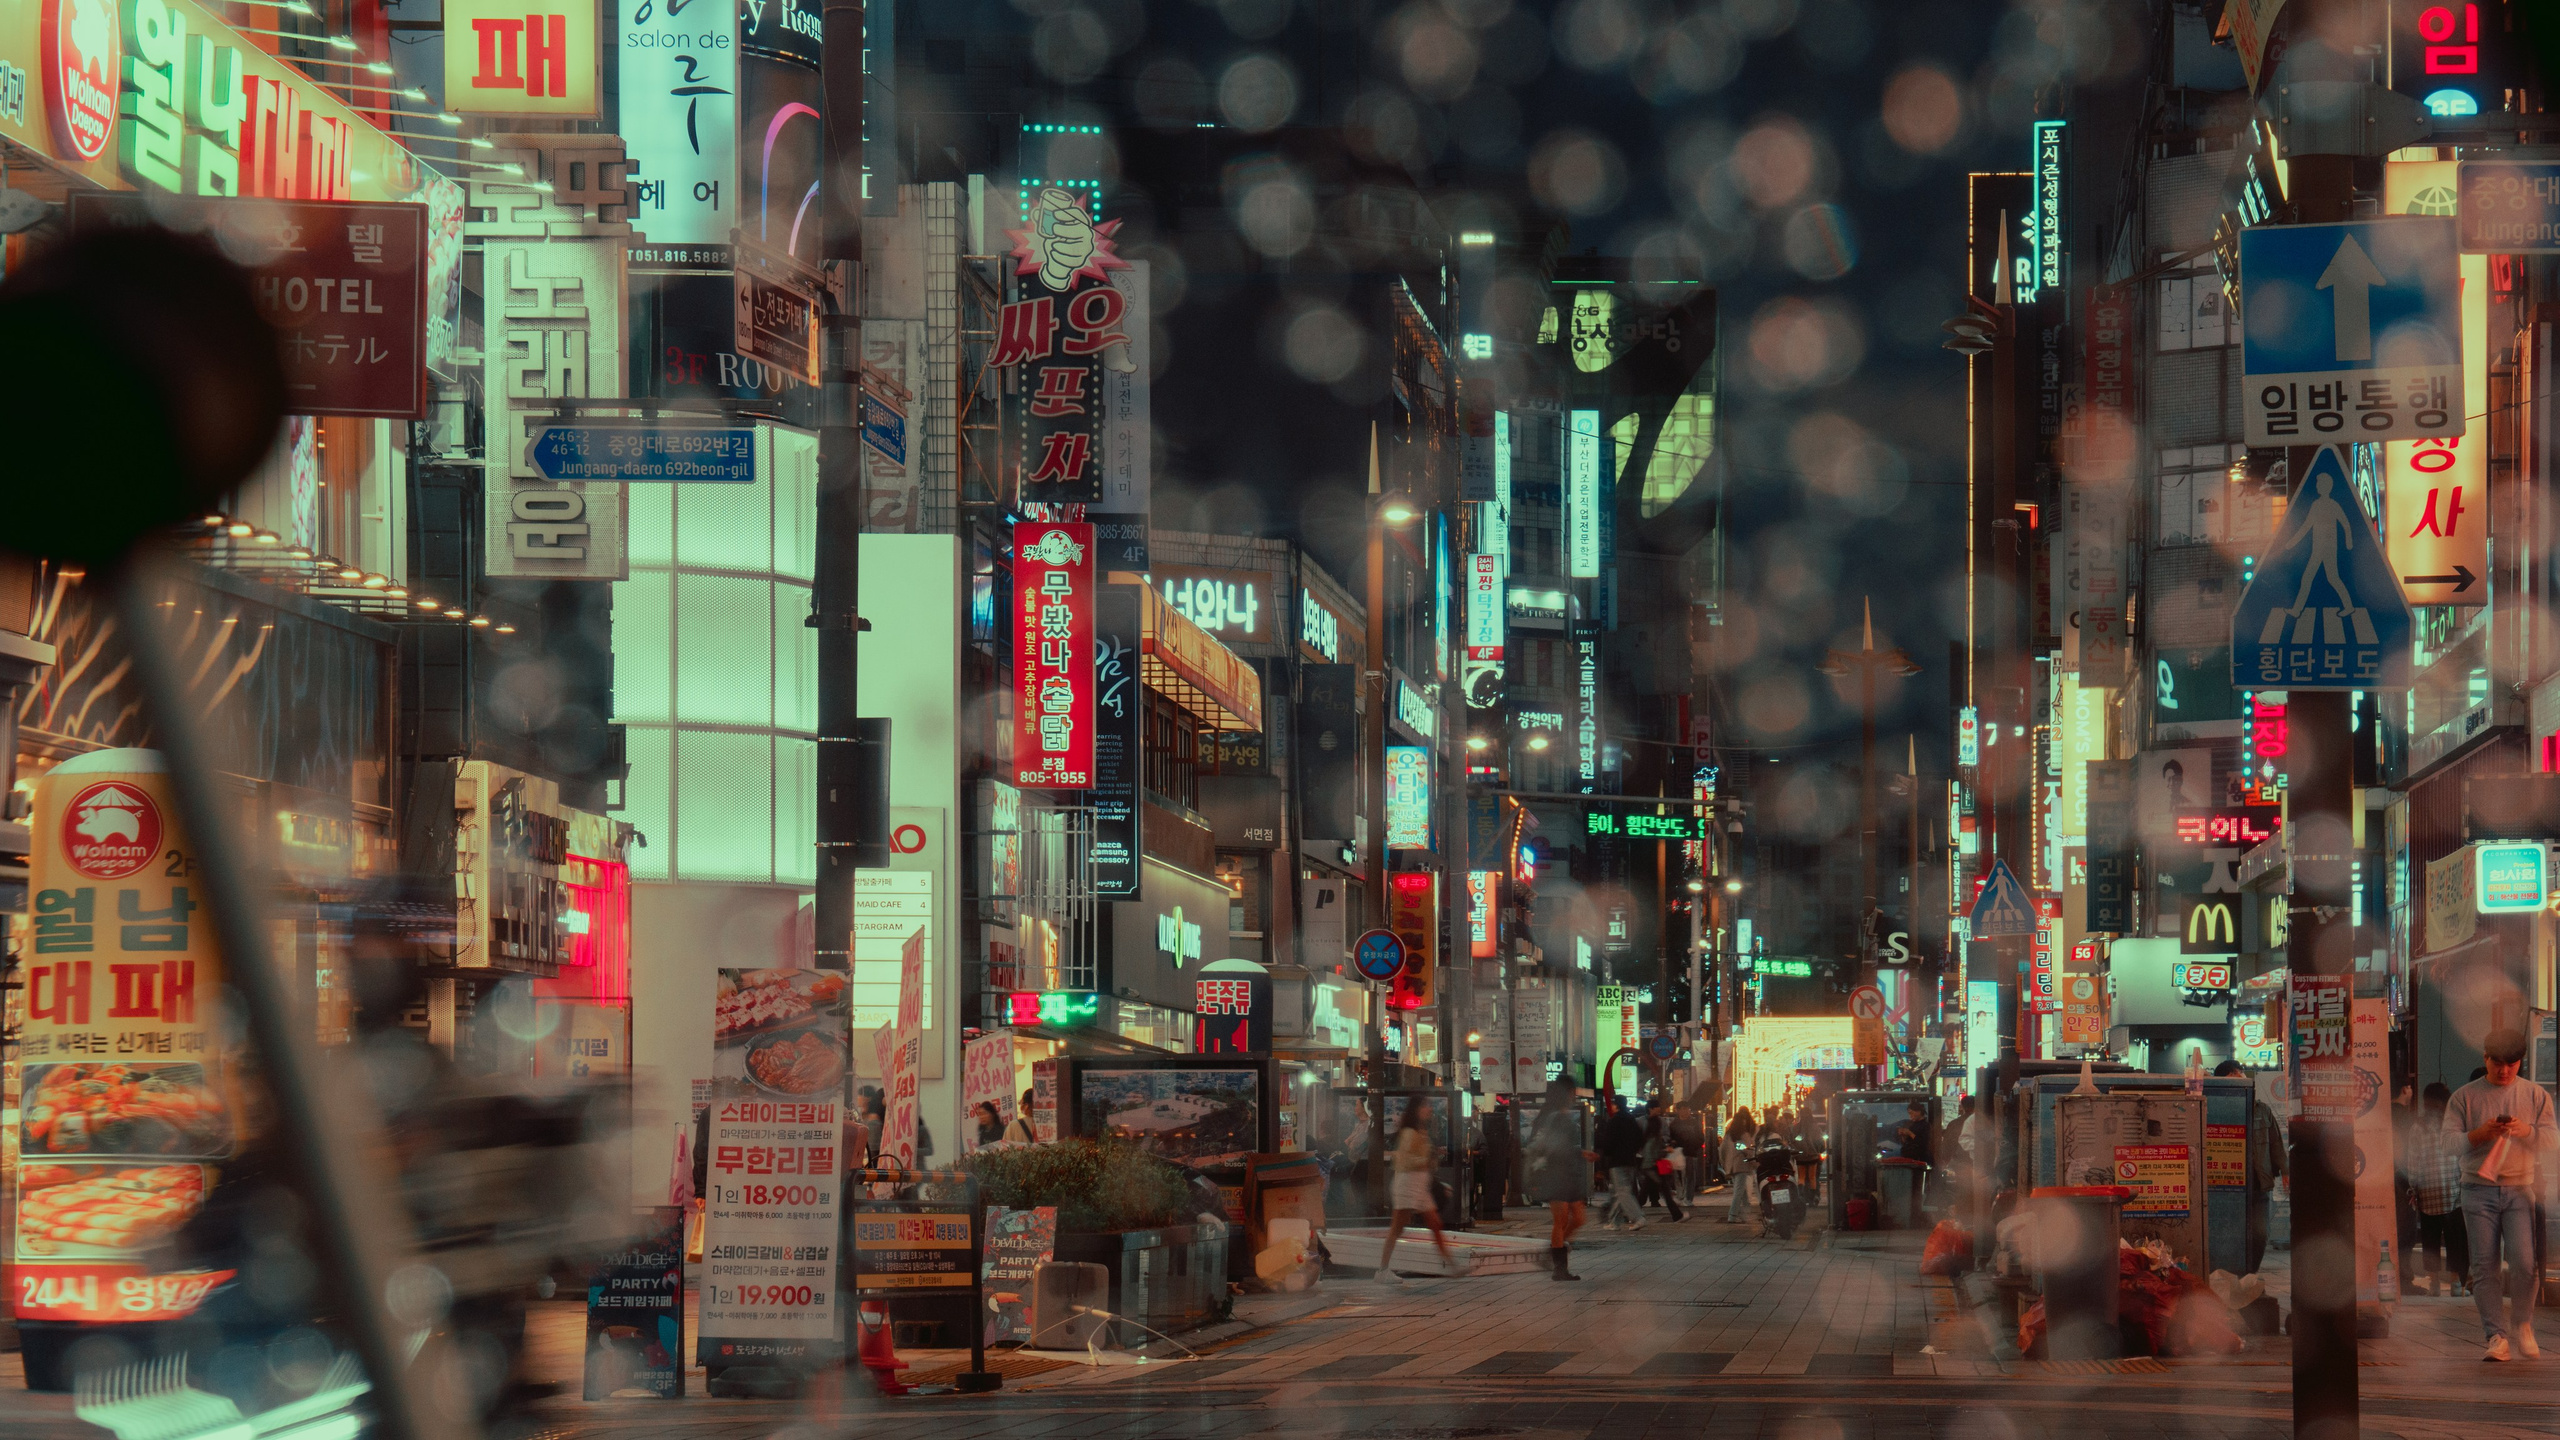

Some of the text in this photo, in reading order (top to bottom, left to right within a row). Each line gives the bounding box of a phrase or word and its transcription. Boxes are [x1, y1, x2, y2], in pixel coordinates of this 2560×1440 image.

[627, 29, 730, 50] salon de
[2419, 4, 2479, 75] 임
[472, 14, 566, 97] 패
[67, 66, 111, 118] Wolnam
[71, 105, 104, 140] Daepae
[258, 277, 384, 315] HOTEL
[2261, 376, 2449, 436] 일방통행
[555, 431, 590, 443] 46-2
[551, 443, 590, 455] 46-12
[607, 435, 749, 459] 중앙대로692번길
[558, 459, 749, 478] Jungang-daero 692beon-gil
[1122, 546, 1145, 562] 4F
[1024, 615, 1036, 629] 맛
[1024, 631, 1036, 656] 원조
[1040, 570, 1074, 752] 무봤나 촌닭
[1477, 647, 1494, 659] 4F
[2258, 648, 2382, 683] 횡단보도
[1024, 659, 1036, 735] 고추장바베큐
[1042, 757, 1066, 771] 본점
[1020, 771, 1087, 784] 805-1955
[1581, 787, 1593, 795] 4F
[1243, 828, 1274, 841] 서면점
[73, 844, 147, 858] Wolnam
[2489, 868, 2536, 882] 회사원
[856, 901, 926, 909] MAID CAFE 4
[35, 886, 197, 955] 월남
[1363, 950, 1397, 960] 주정차금지
[2074, 947, 2093, 960] 5G
[2294, 975, 2319, 983] CUSTOM
[2318, 975, 2341, 983] FITNESS
[29, 960, 196, 1025] 대패
[1597, 987, 1620, 999] ABC
[2067, 1016, 2101, 1033] 안경
[2244, 1050, 2273, 1063] 스타
[720, 1102, 835, 1124] 스테이크갈비
[715, 1145, 834, 1175] 무한리필
[714, 1184, 739, 1204] 1인
[765, 1211, 783, 1219] 6,000
[921, 1219, 935, 1241] 거리
[1000, 1256, 1037, 1266] PARTY
[611, 1278, 661, 1290] PARTY
[597, 1295, 673, 1308] 보드게임카페
[709, 1285, 733, 1304] 1인
